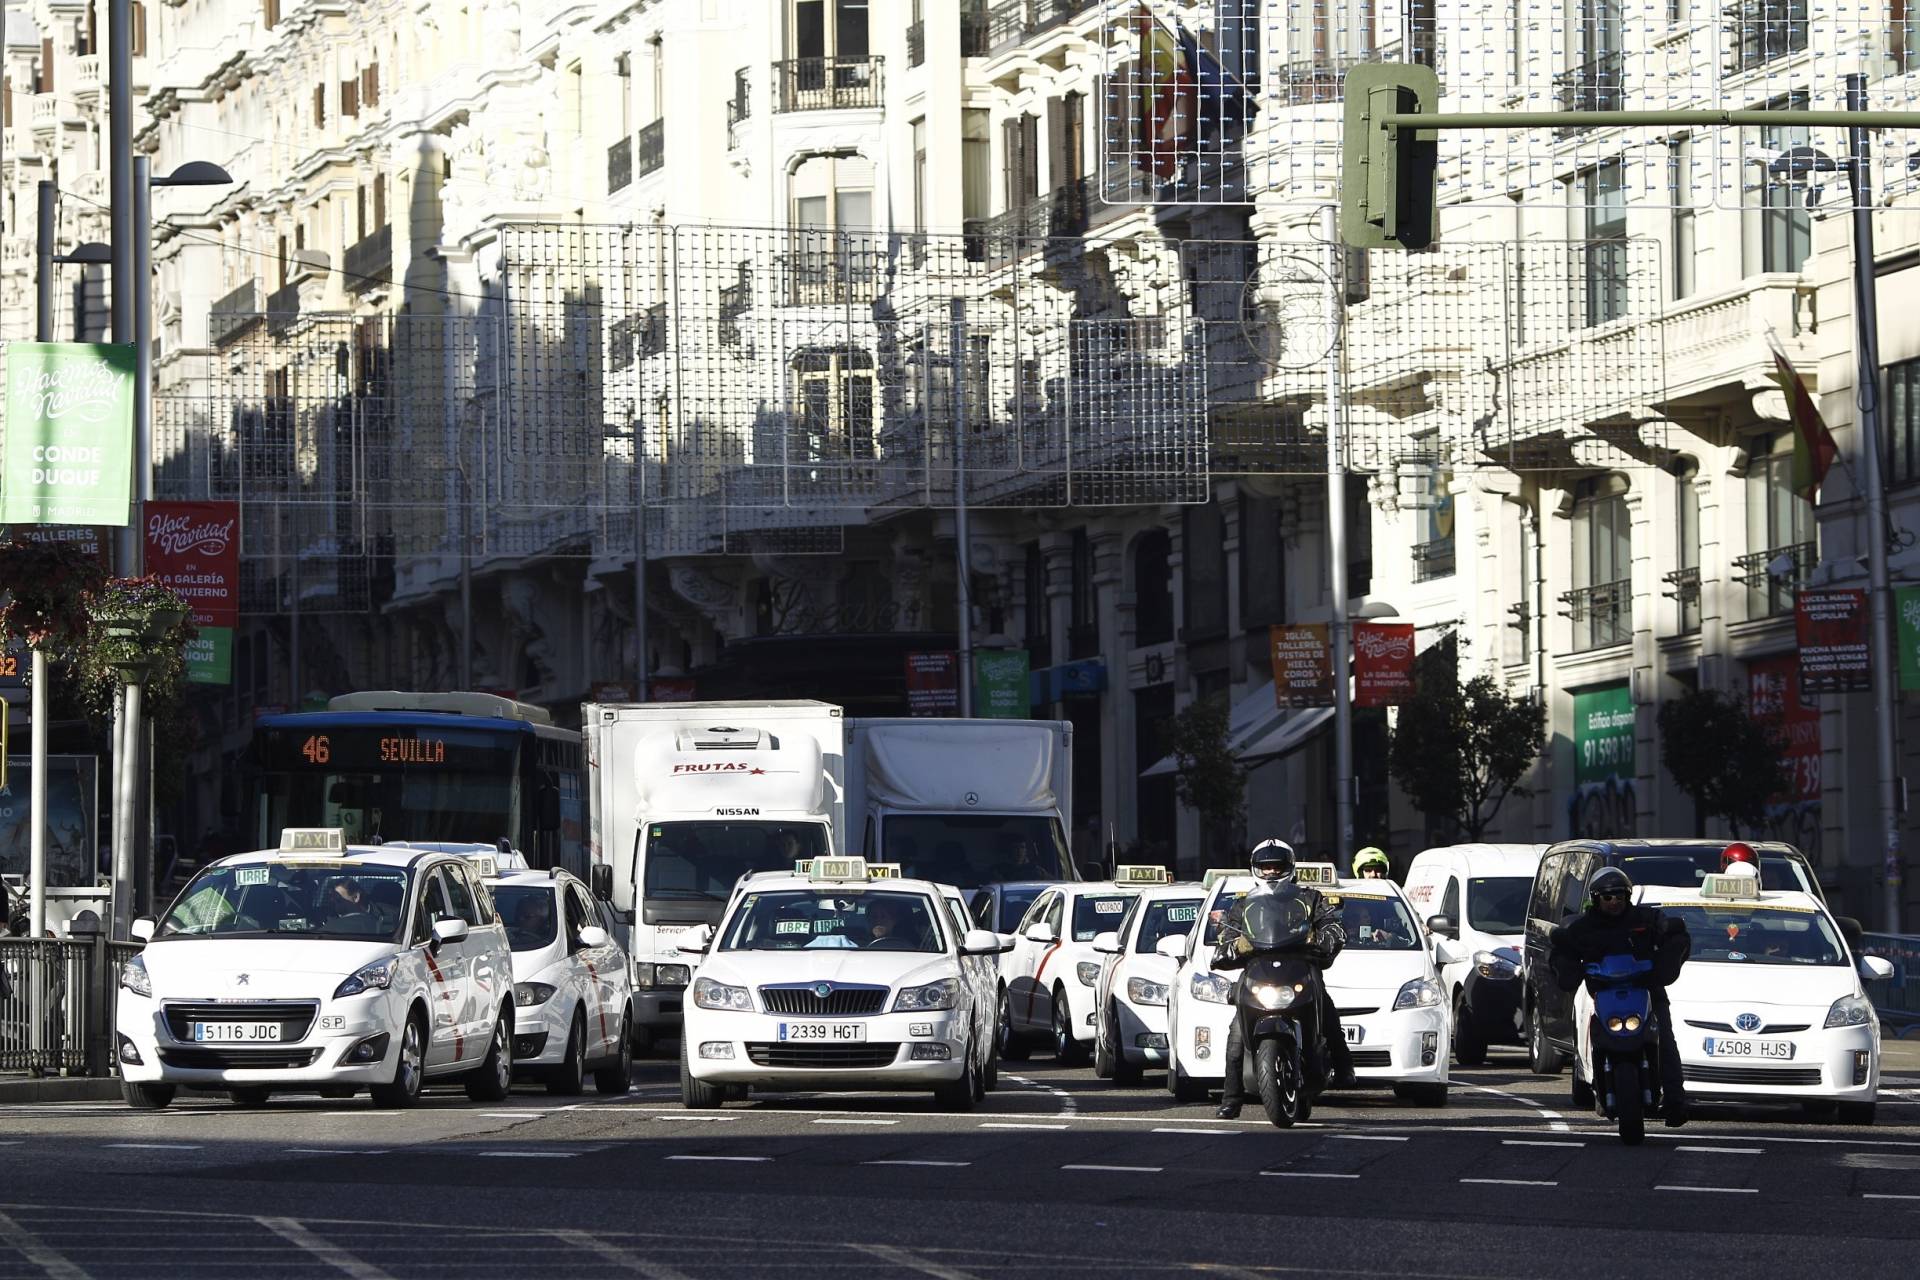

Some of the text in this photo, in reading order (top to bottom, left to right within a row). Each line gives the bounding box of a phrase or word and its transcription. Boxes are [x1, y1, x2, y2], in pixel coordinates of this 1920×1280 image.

[31, 373, 126, 422] Navidad
[32, 446, 102, 462] CONDE
[31, 468, 100, 485] DUQUE
[48, 507, 96, 517] MADRID
[149, 514, 190, 544] Hace
[161, 519, 234, 555] Navidad
[175, 572, 224, 584] GALERÍA
[1278, 650, 1325, 659] PISTAS DE
[1831, 644, 1867, 652] NAVIDAD
[185, 651, 215, 662] UQUE
[1800, 655, 1835, 663] CUANDO
[1810, 663, 1837, 671] CONDE
[1839, 662, 1867, 670] DUQUE
[1284, 670, 1314, 678] COROS
[1290, 680, 1318, 688] NIEVE
[303, 736, 444, 763] 46 SEVILLA
[1584, 739, 1596, 767] 91
[1599, 736, 1618, 766] 598
[673, 762, 748, 773] FRUTAS
[716, 808, 760, 816] NISSAN
[296, 833, 328, 847] TAXI
[825, 862, 849, 876] TAXI
[1131, 869, 1155, 879] TAXI
[1296, 868, 1320, 882] TAXI
[1716, 879, 1741, 893] TAXI
[1096, 902, 1122, 912] OCUPADO
[1169, 907, 1196, 921] LIBRE
[206, 1025, 277, 1039] 5116 JDC
[791, 1025, 860, 1039] 2339 HGT
[1717, 1041, 1787, 1056] 4508 HJS
